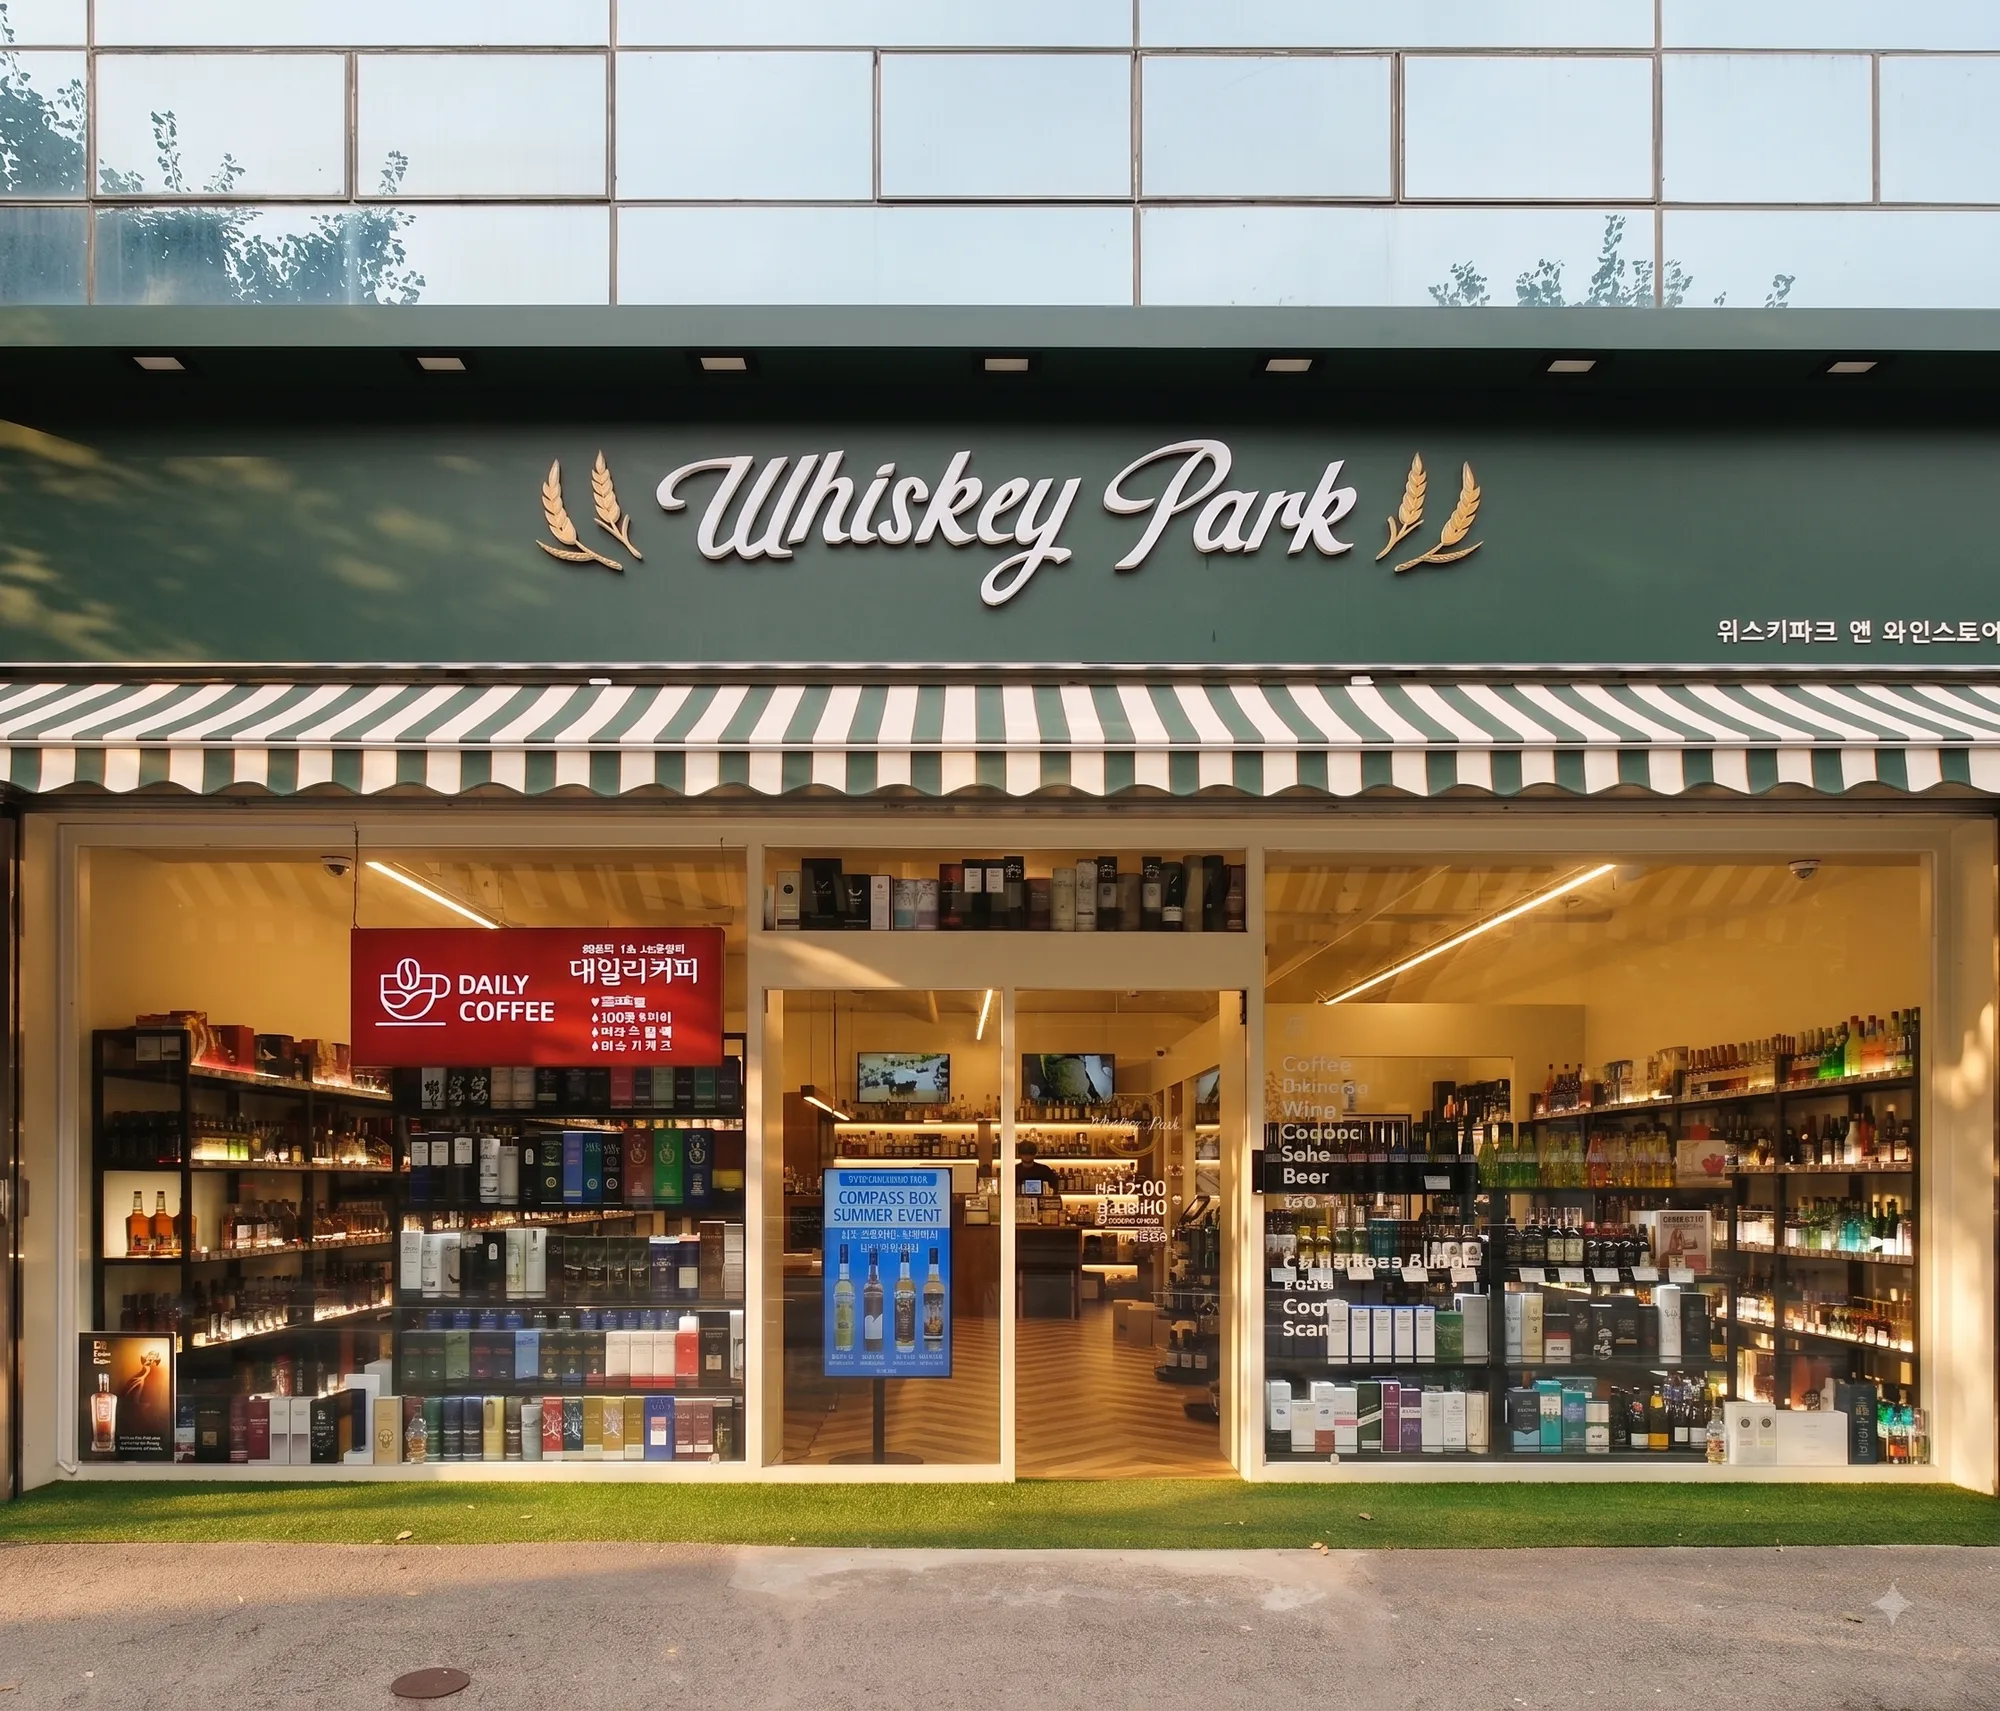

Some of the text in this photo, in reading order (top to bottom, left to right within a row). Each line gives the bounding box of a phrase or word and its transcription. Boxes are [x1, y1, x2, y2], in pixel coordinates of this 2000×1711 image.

[656, 439, 1357, 606] Whiskey Park
[1717, 619, 1838, 644] 위스키파크
[1849, 619, 1873, 644] 앤
[569, 957, 698, 986] 대일리커피
[459, 974, 530, 995] DAILY
[459, 1000, 555, 1023] COFFEE
[1283, 1167, 1330, 1184] Beer
[839, 1191, 938, 1205] COMPASS BOX
[833, 1208, 942, 1222] SUMMER EVENT
